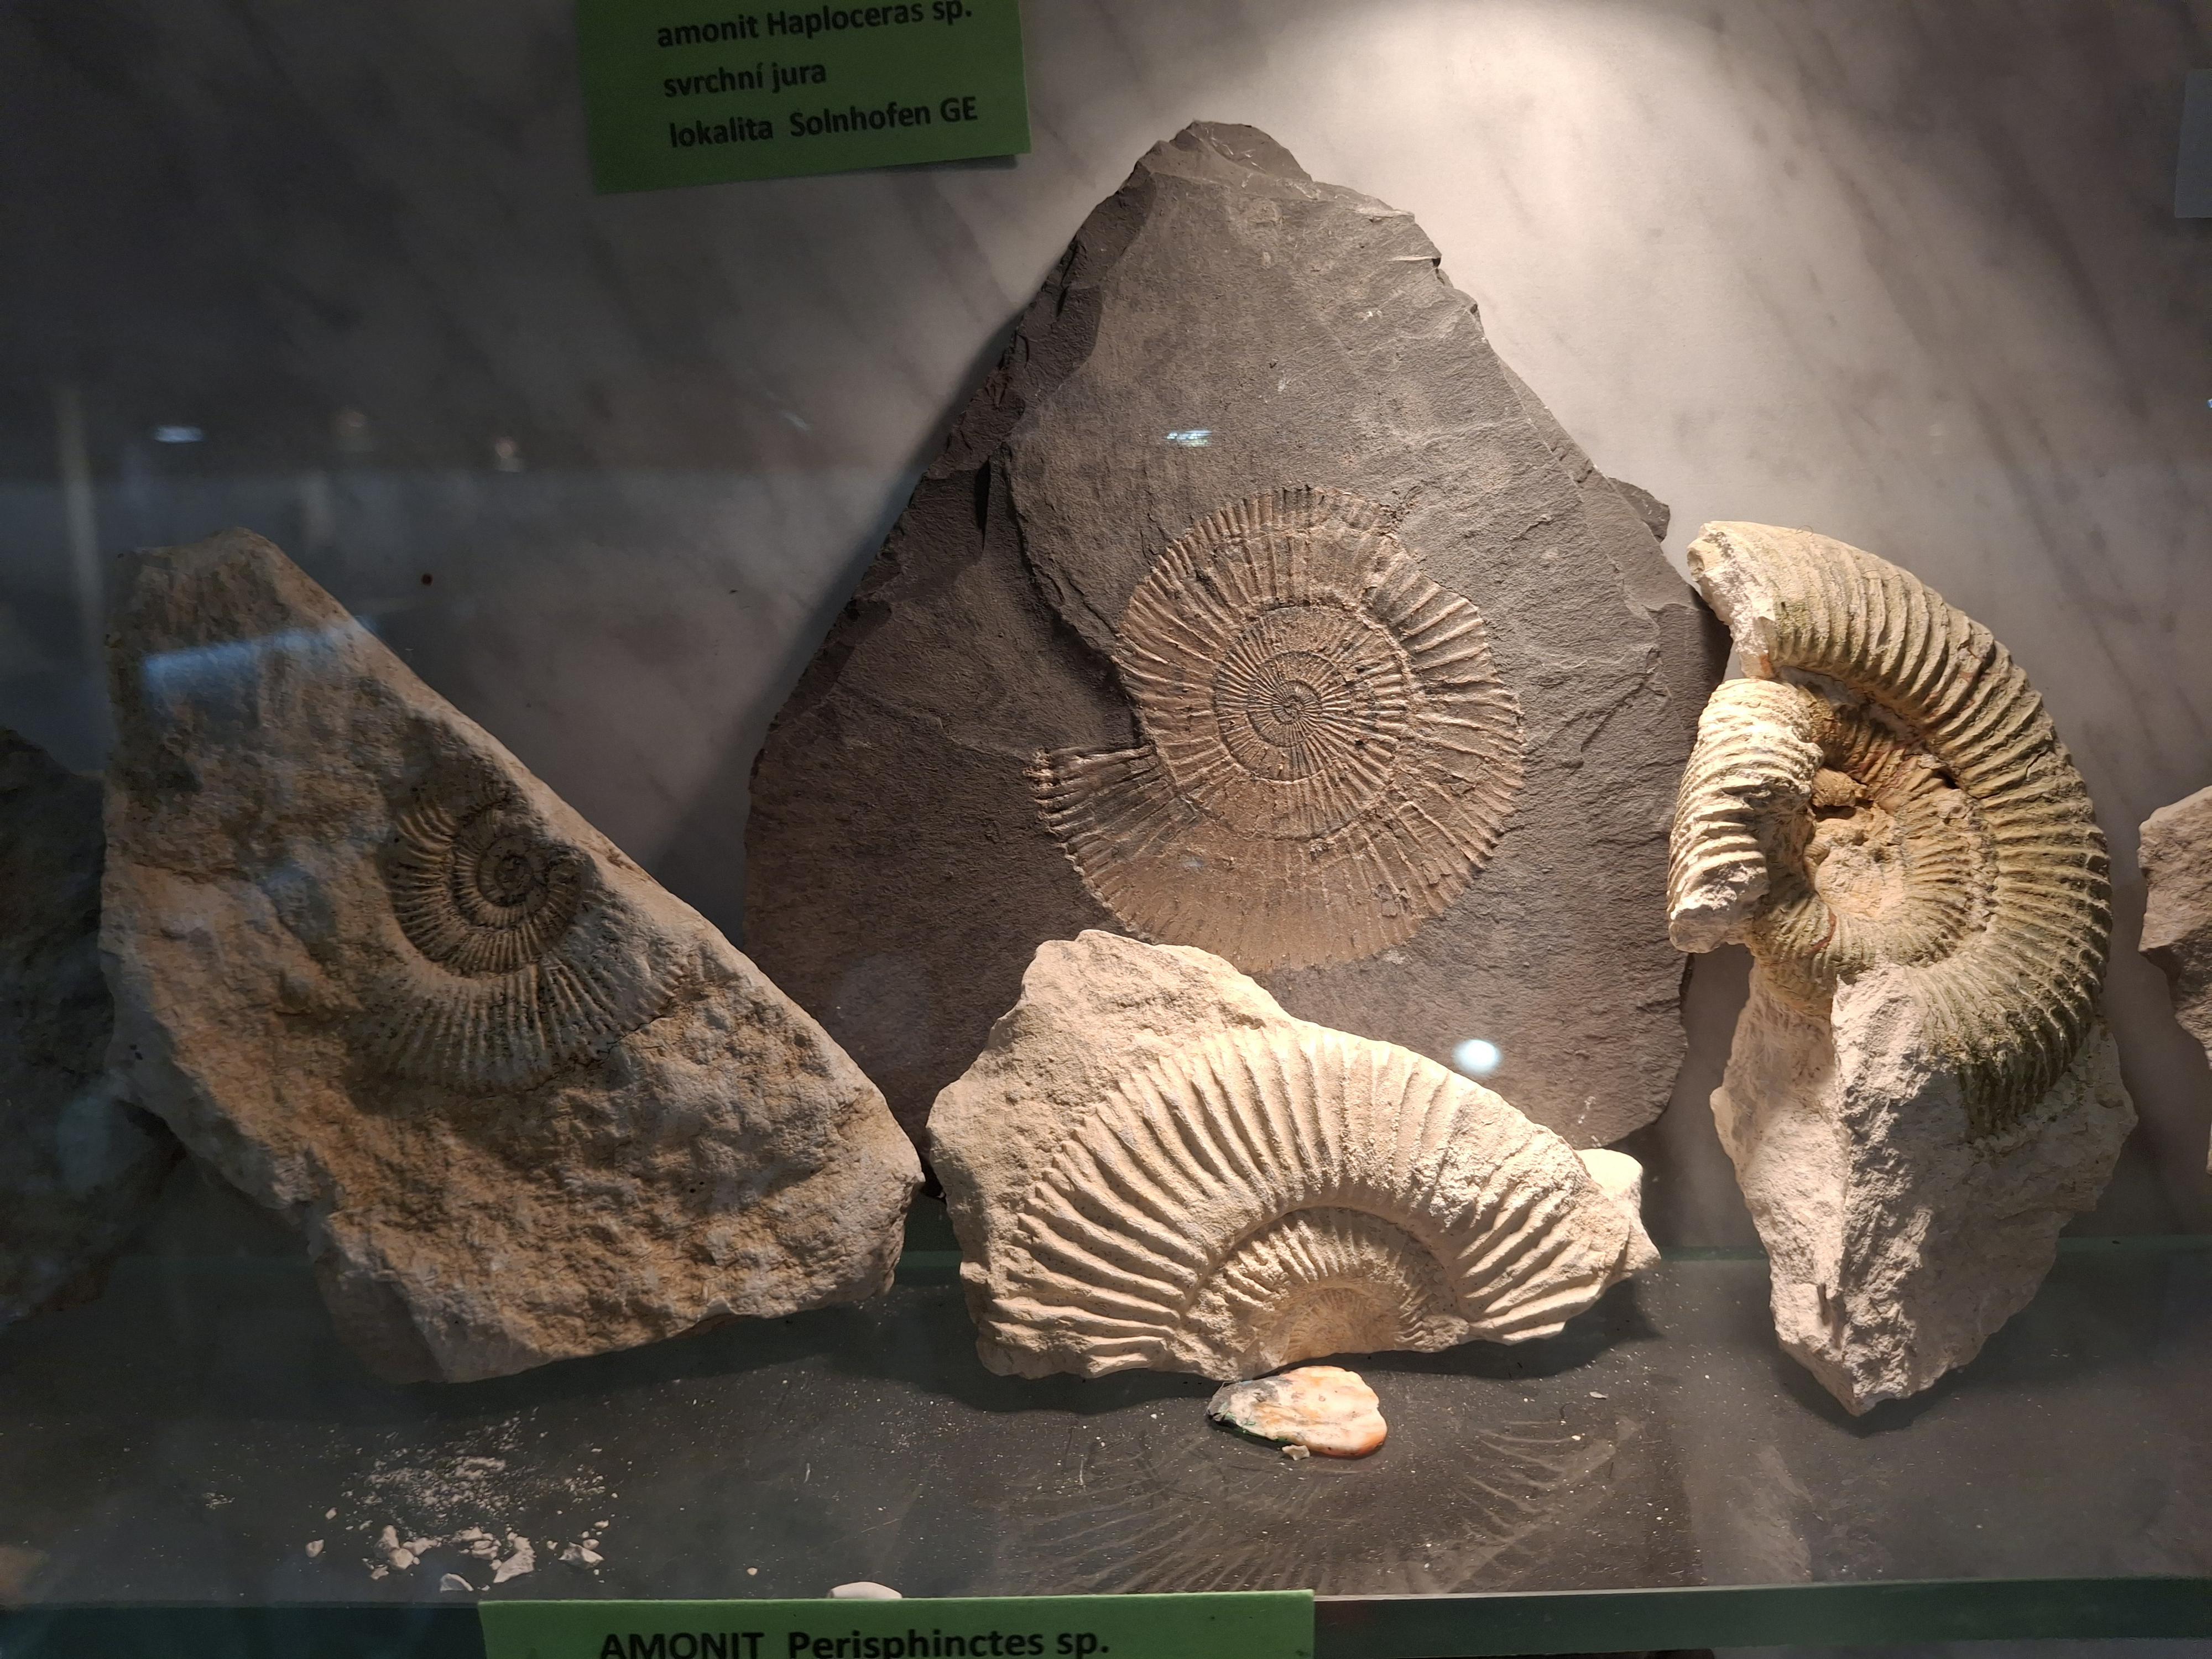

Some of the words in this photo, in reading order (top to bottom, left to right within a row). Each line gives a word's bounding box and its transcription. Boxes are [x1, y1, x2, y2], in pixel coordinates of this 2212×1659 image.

[658, 14, 759, 47] amonit
[768, 3, 924, 39] Haploceras
[932, 0, 972, 25] sp.
[664, 62, 764, 97] svrchní
[771, 62, 827, 93] jura
[670, 117, 774, 148] lokalita
[790, 101, 931, 138] Solnhofen
[940, 96, 978, 122] GE
[600, 1631, 765, 1659] AMONIT
[789, 1629, 1045, 1659] Perisphinctes
[1056, 1632, 1109, 1659] sp.
